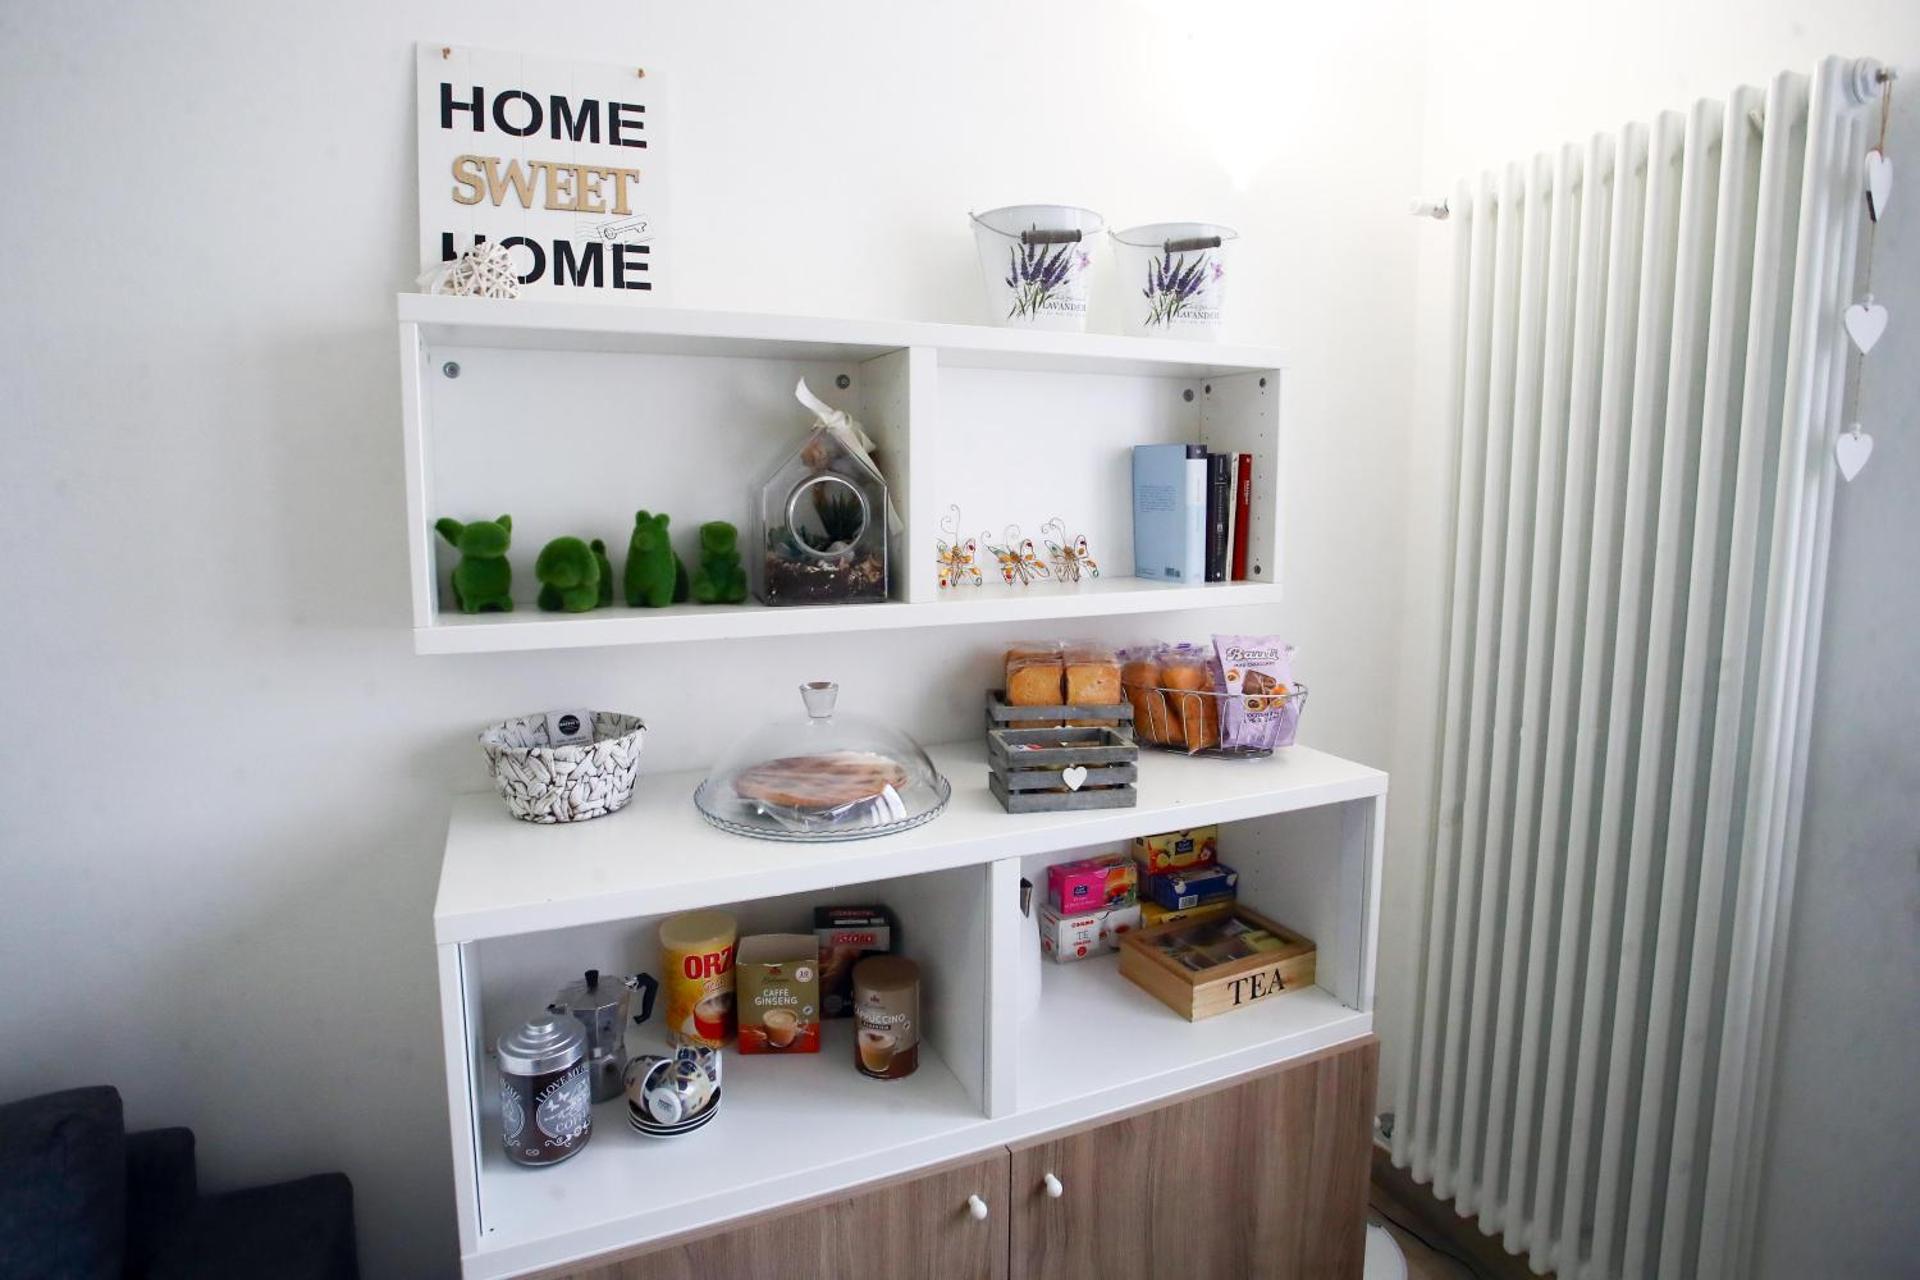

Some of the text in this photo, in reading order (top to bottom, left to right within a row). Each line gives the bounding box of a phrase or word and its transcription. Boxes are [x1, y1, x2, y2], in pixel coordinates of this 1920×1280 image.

[440, 82, 648, 149] HOME
[452, 154, 641, 216] SWEET
[684, 945, 735, 980] ORZ
[754, 996, 798, 1006] GINSENG
[1226, 968, 1285, 1005] TEA
[540, 1075, 567, 1099] LOVE
